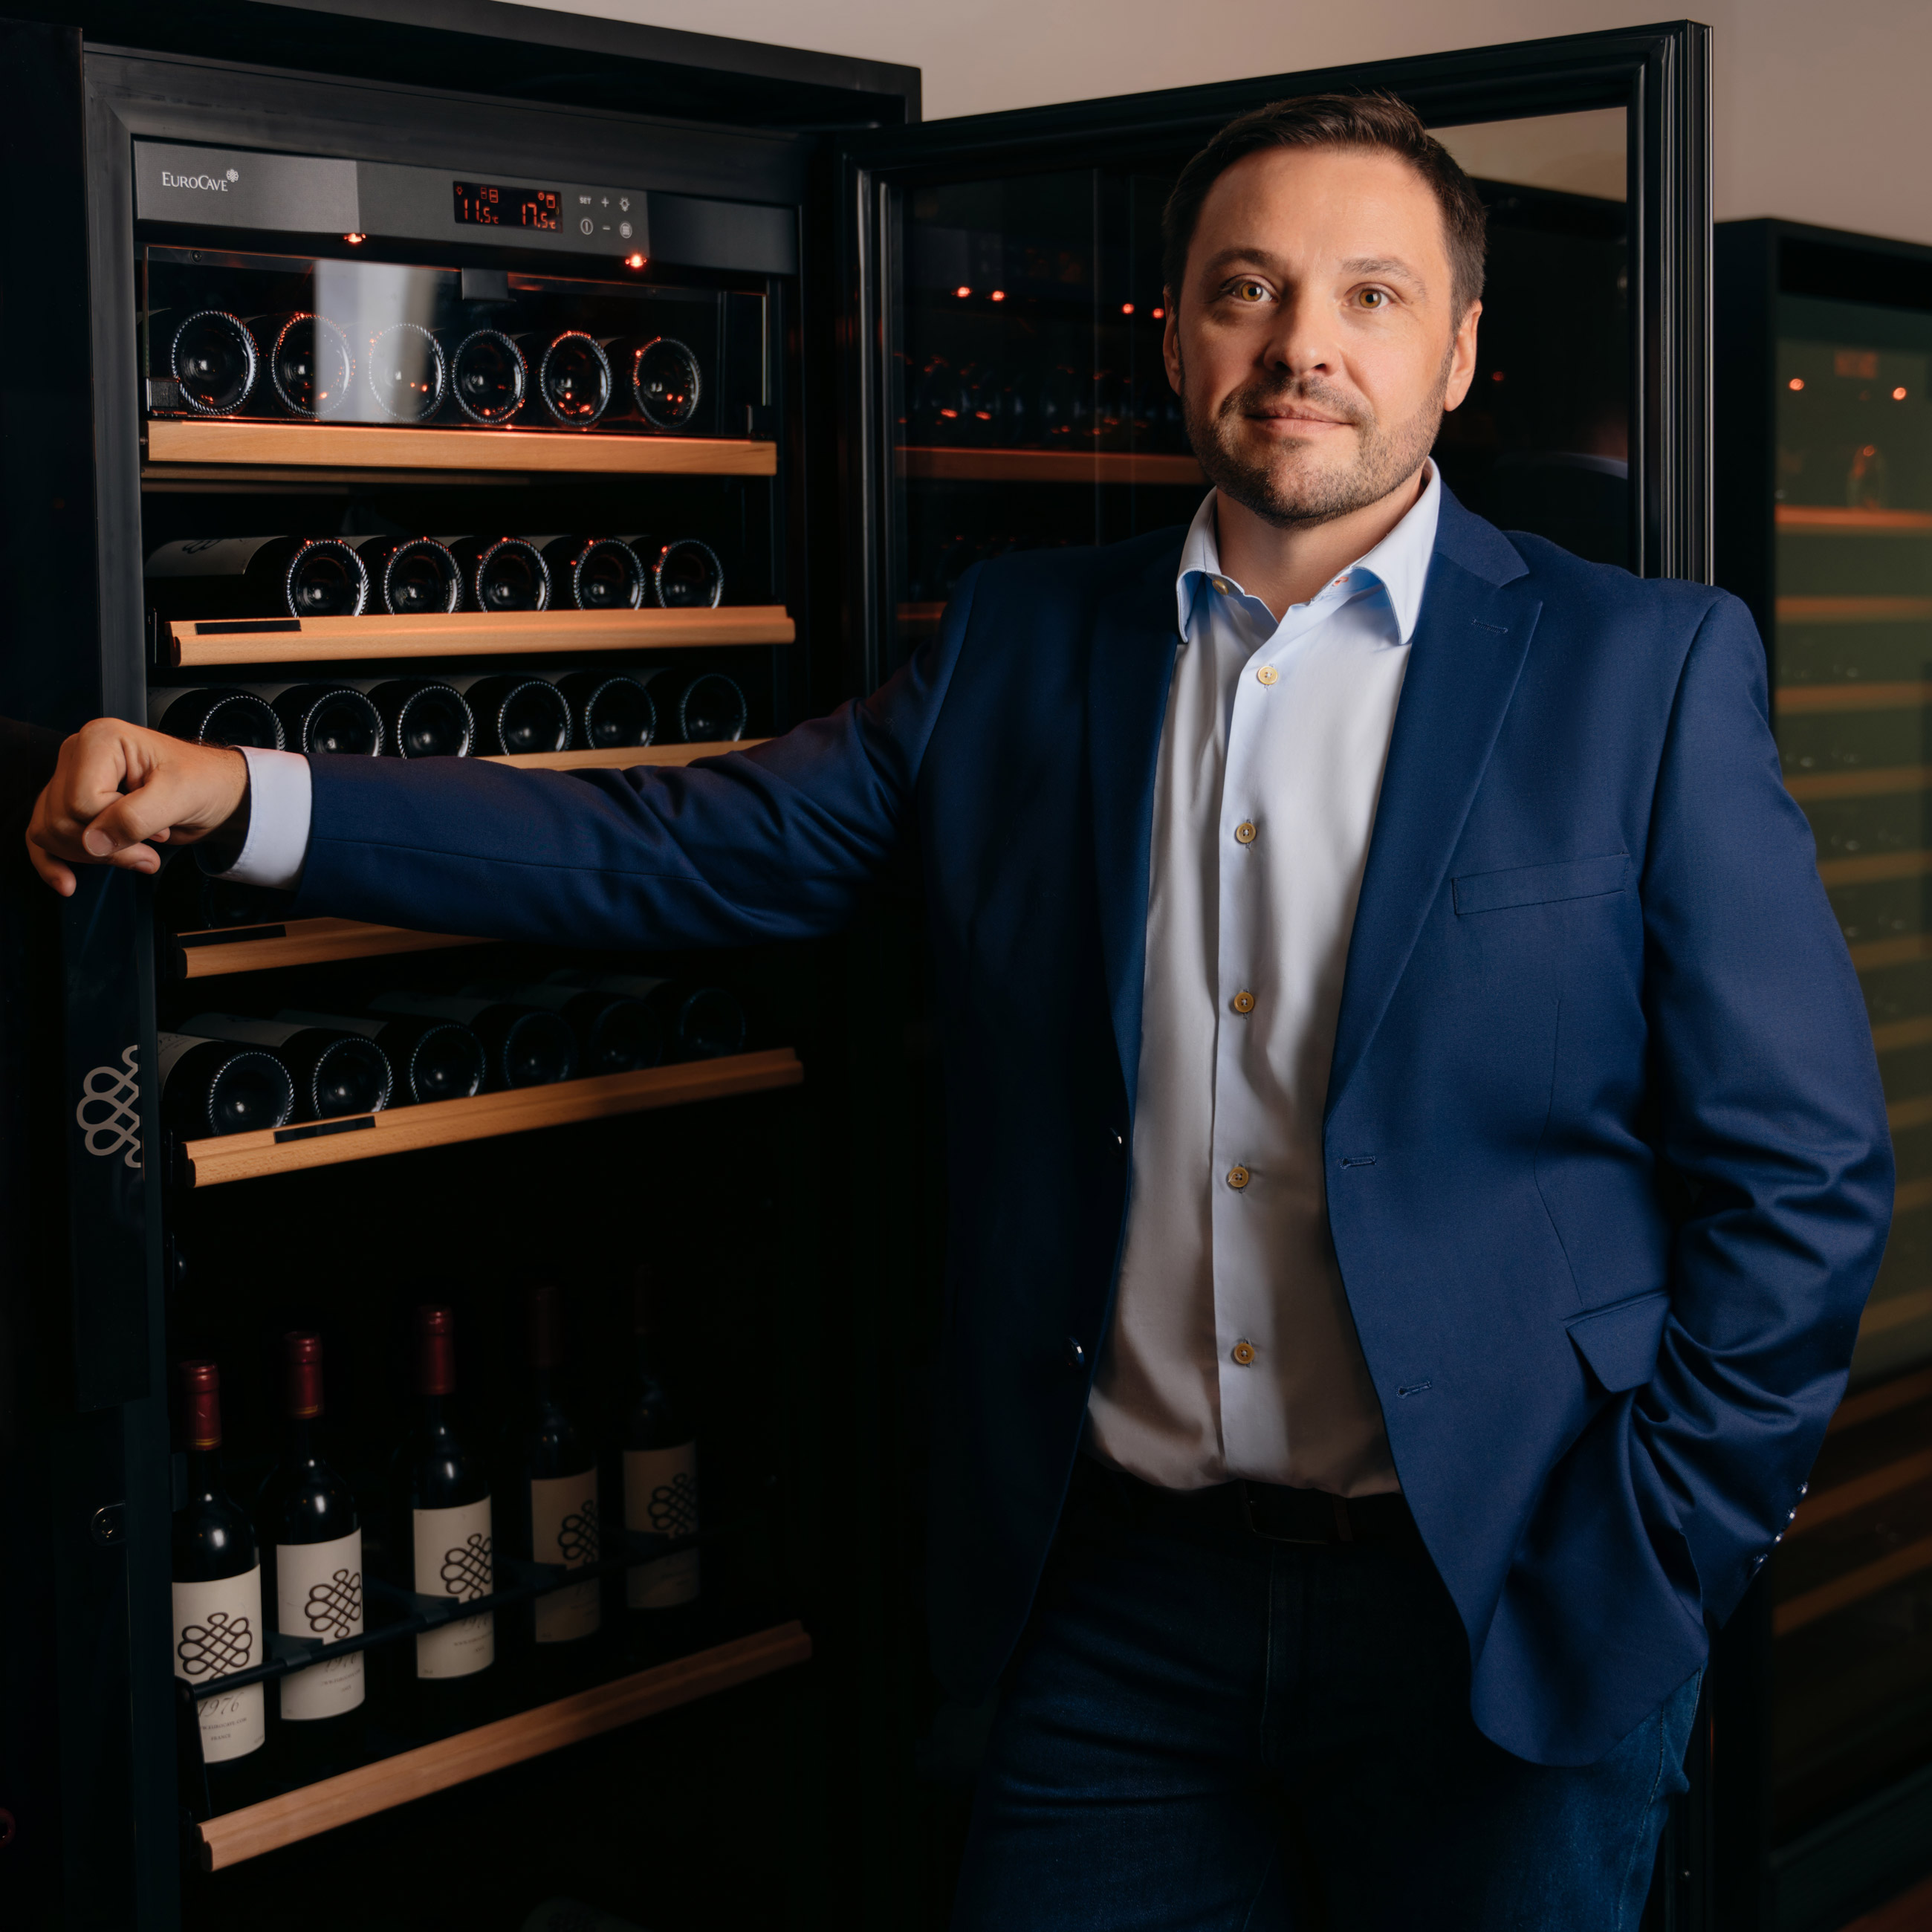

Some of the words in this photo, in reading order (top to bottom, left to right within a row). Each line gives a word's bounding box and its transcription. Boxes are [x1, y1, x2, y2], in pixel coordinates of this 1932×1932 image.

[579, 196, 592, 204] SET
[198, 1691, 244, 1717] 1976
[210, 1733, 231, 1742] FRANCE
